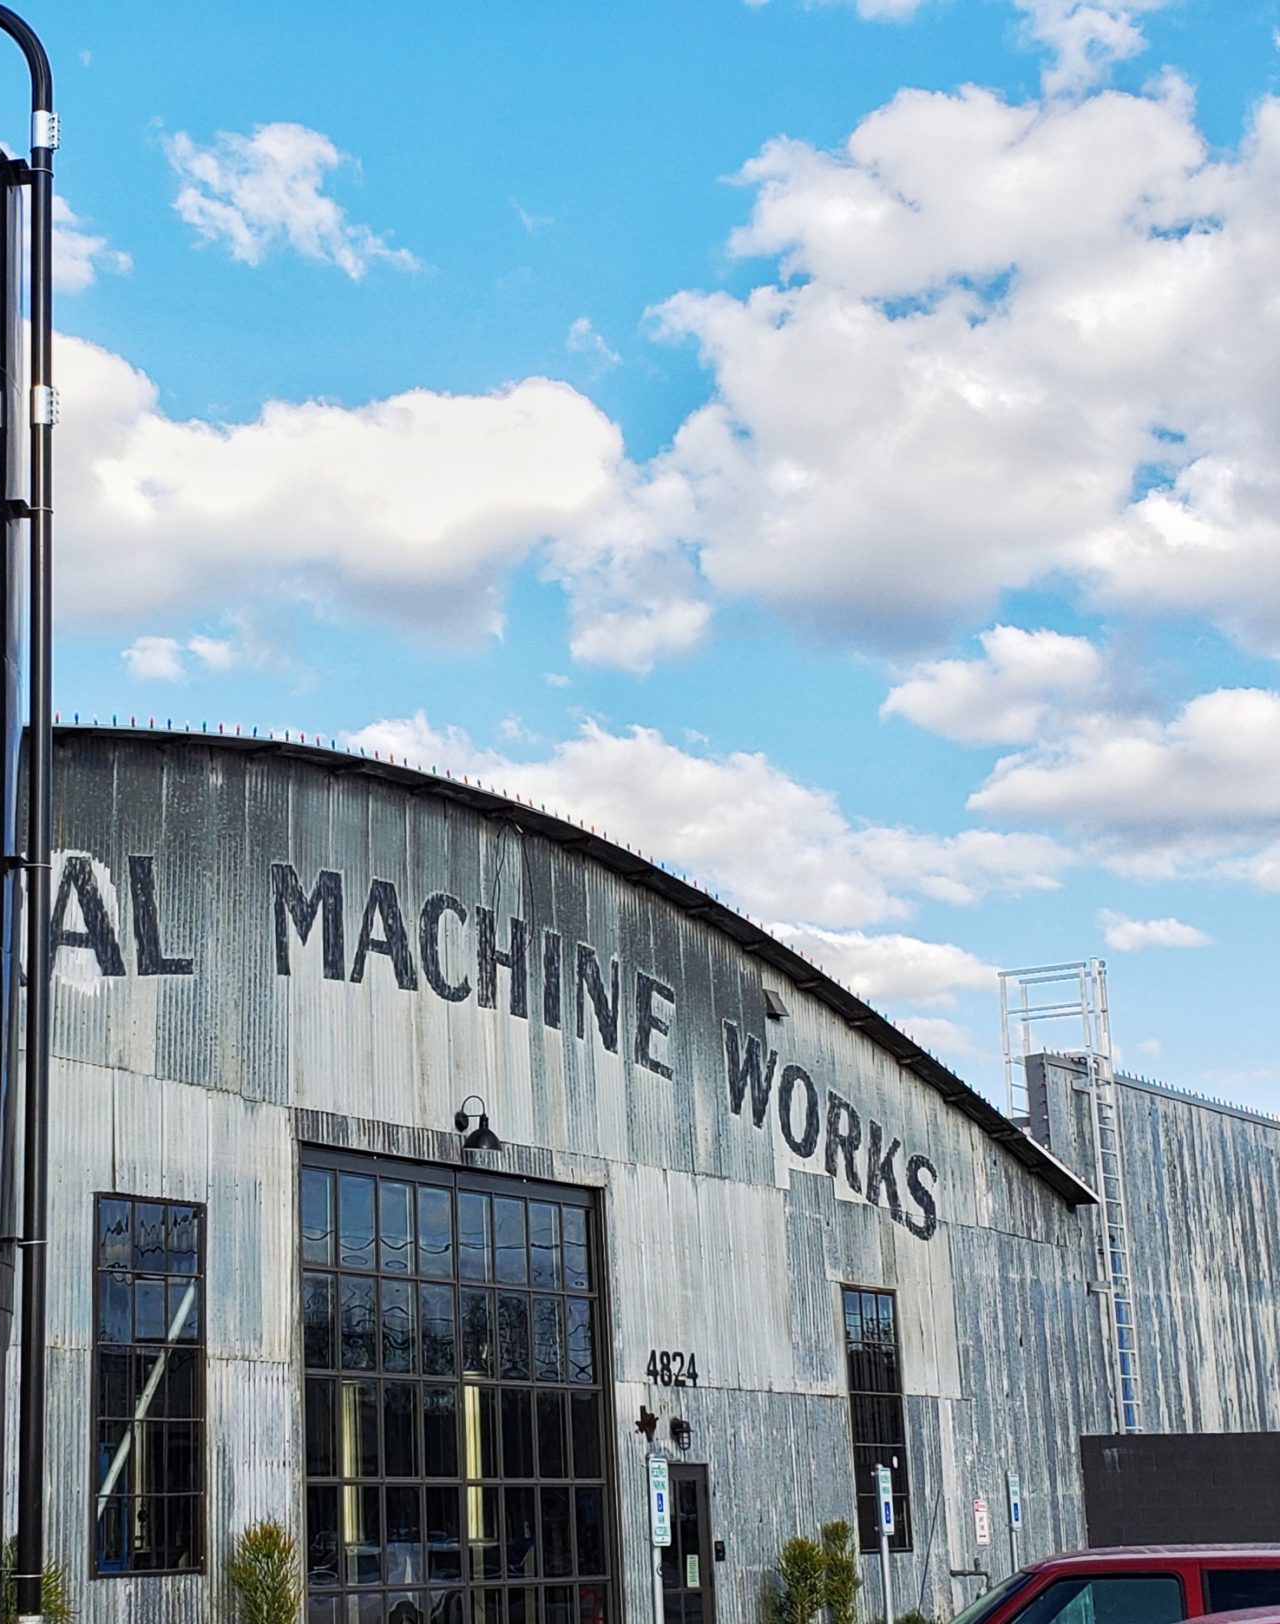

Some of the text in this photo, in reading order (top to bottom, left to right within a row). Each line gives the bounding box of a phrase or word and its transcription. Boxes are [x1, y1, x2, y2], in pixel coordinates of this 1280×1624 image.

[19, 855, 939, 1242] AL MACHINE WORKS
[646, 1349, 699, 1388] 4824
